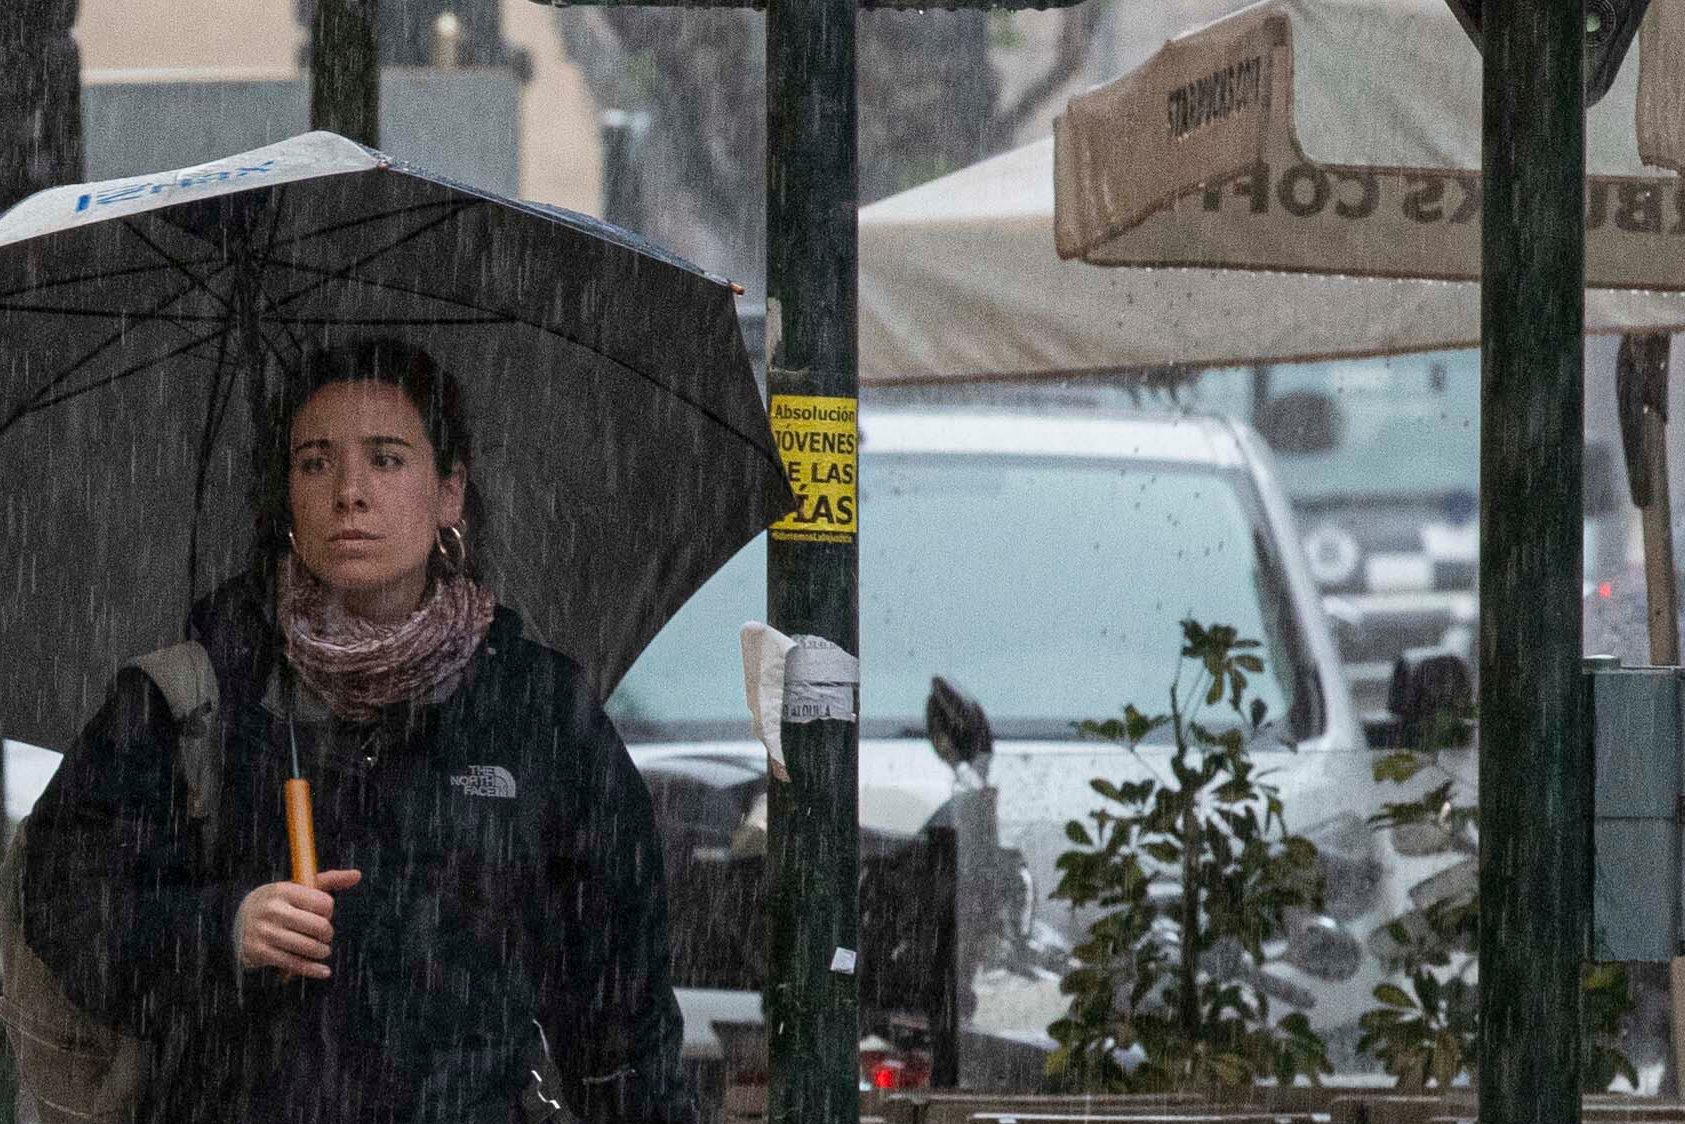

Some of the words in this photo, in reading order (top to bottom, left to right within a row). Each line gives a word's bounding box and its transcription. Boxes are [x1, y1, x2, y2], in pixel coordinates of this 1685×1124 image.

[787, 461, 801, 483] E
[811, 462, 854, 484] LAS
[787, 484, 854, 525] ÍAS
[468, 765, 495, 775] THE
[450, 775, 495, 786] NORTH
[464, 785, 496, 797] FACE
